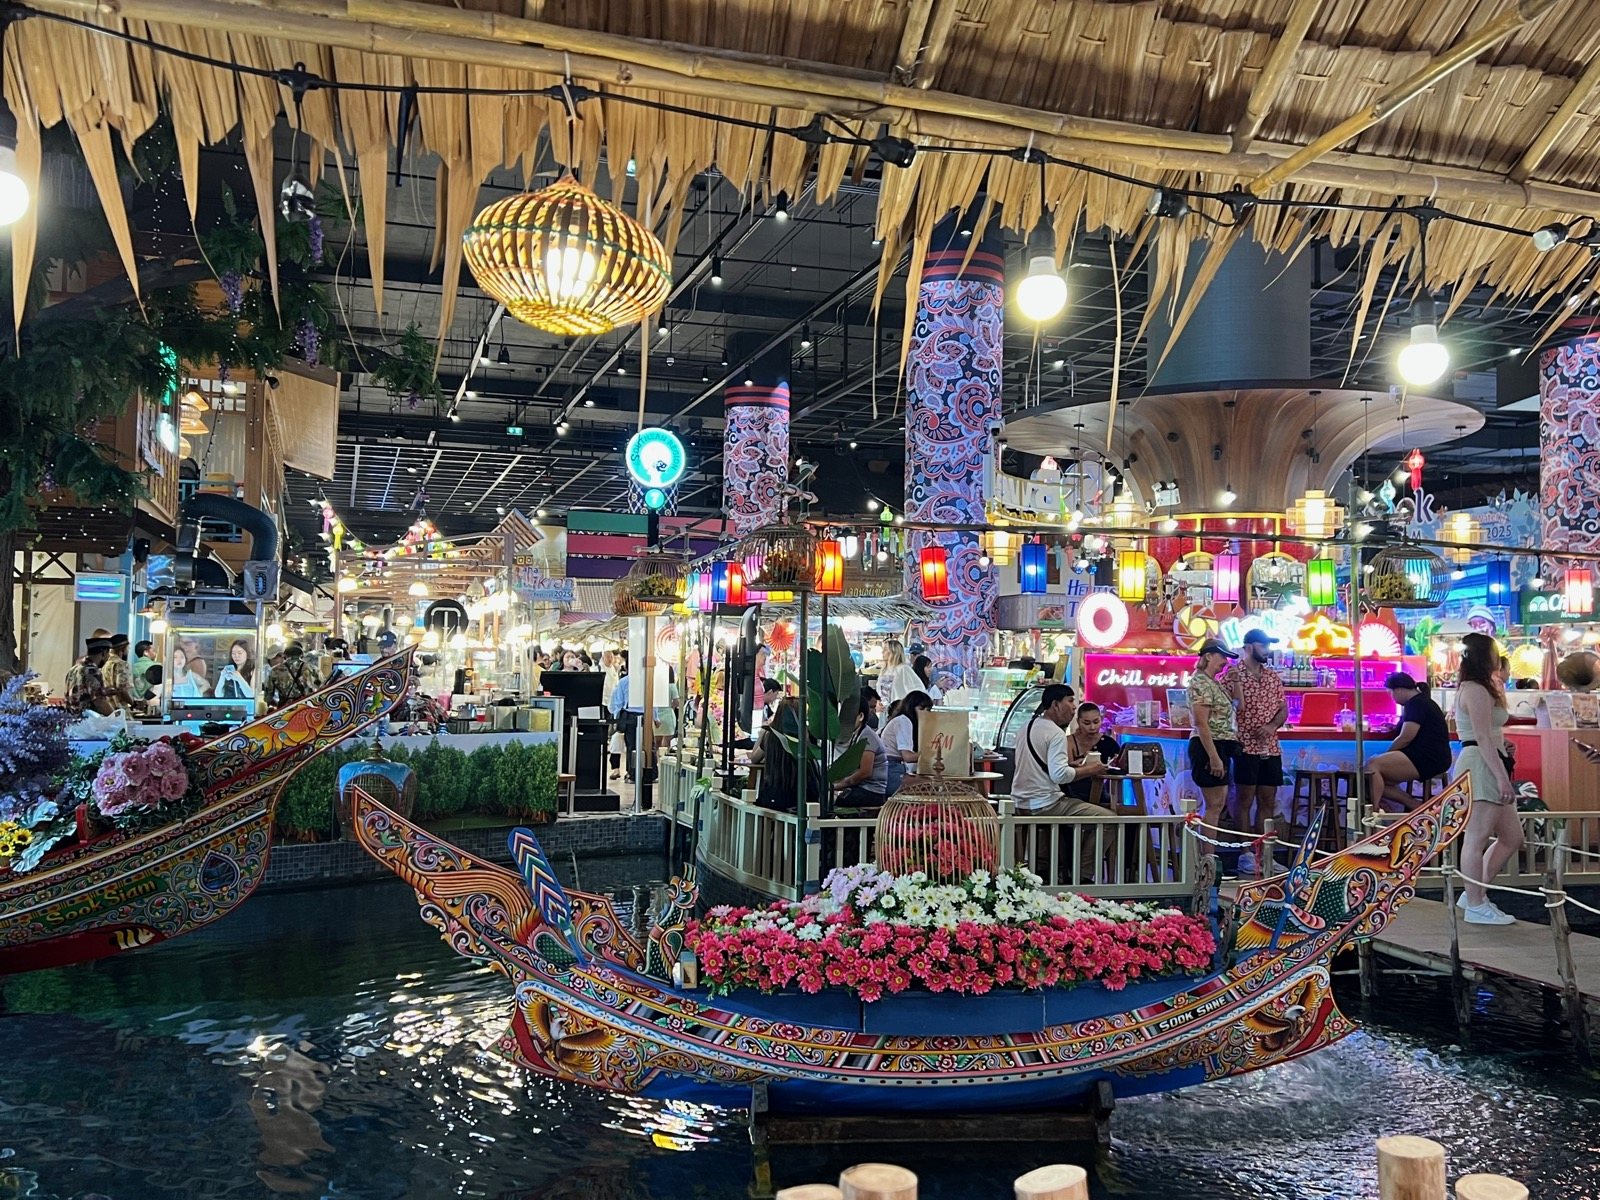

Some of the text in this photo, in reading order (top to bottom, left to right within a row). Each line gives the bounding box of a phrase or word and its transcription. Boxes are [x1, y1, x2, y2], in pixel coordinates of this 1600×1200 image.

[1097, 669, 1144, 686] Chill
[1147, 671, 1178, 687] out
[46, 881, 156, 924] Sook Siam
[1159, 1011, 1194, 1032] SOOK
